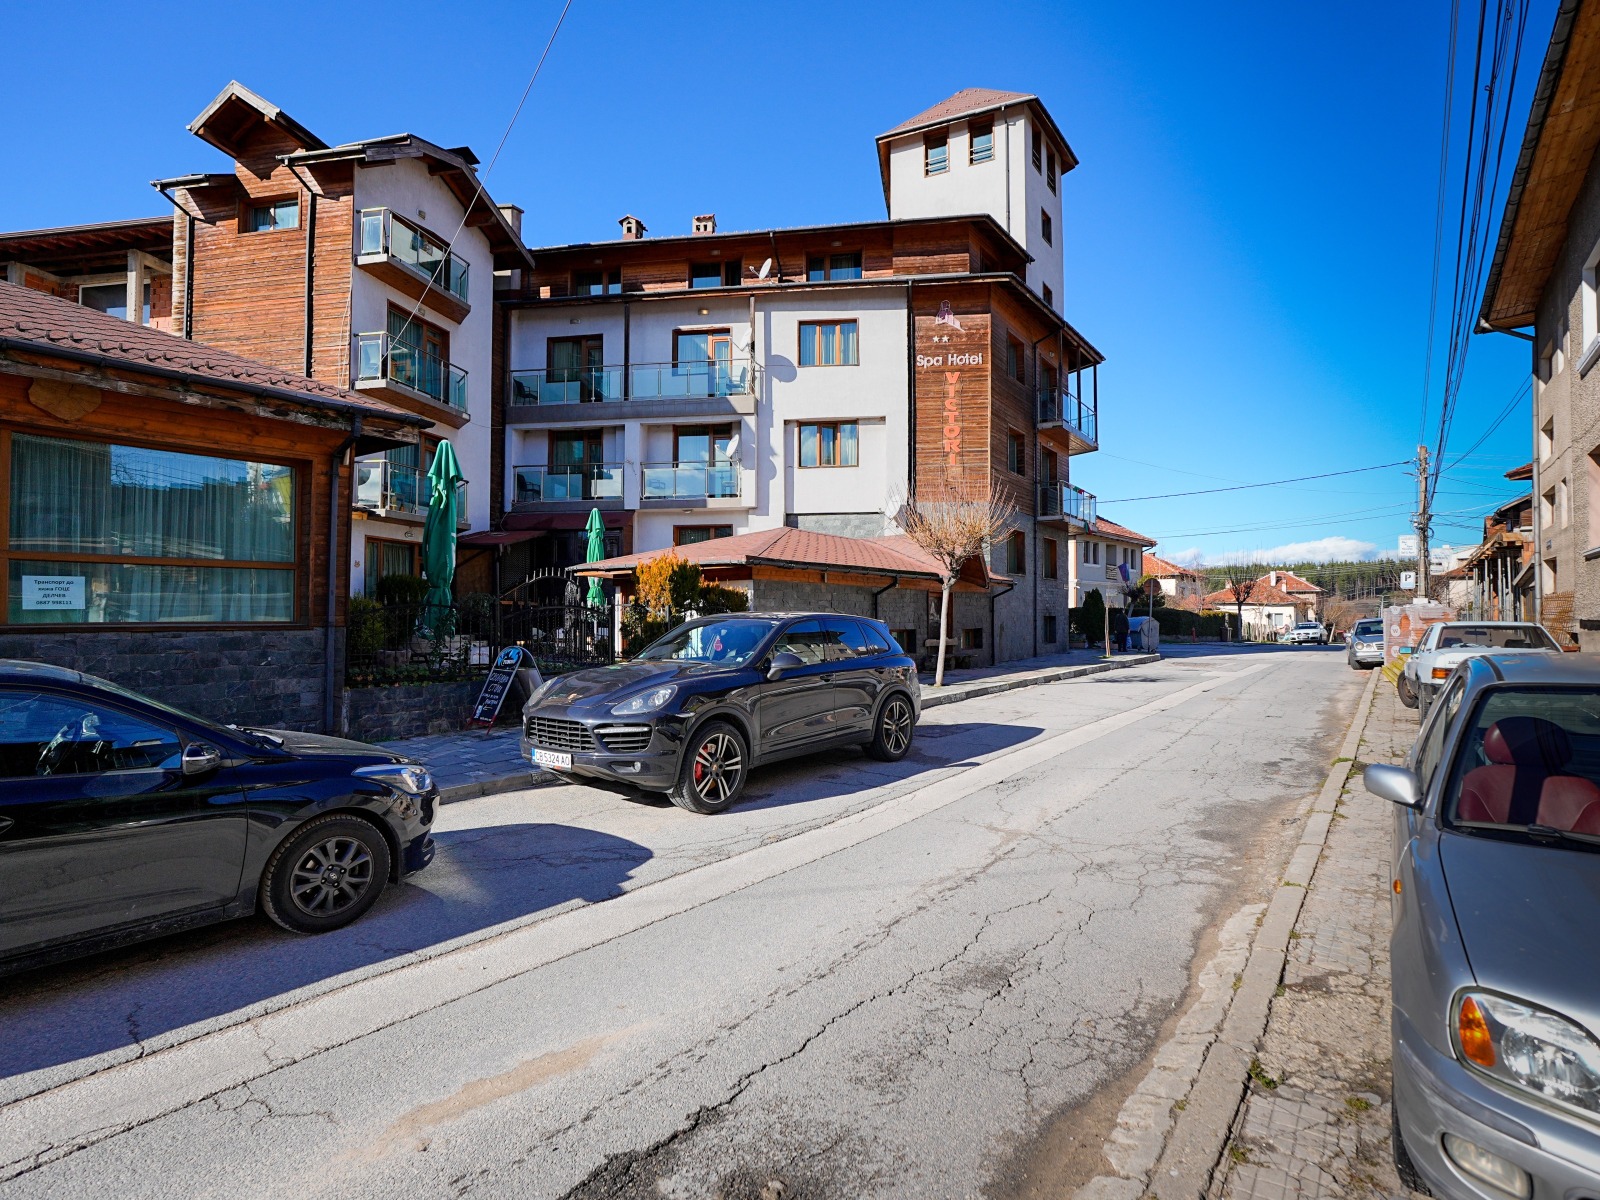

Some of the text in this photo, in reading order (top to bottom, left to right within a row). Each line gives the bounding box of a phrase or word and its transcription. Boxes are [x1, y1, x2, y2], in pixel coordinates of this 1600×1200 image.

[916, 353, 983, 368] Spa Hotel
[943, 372, 961, 465] VICTORI
[543, 752, 560, 765] 5324
